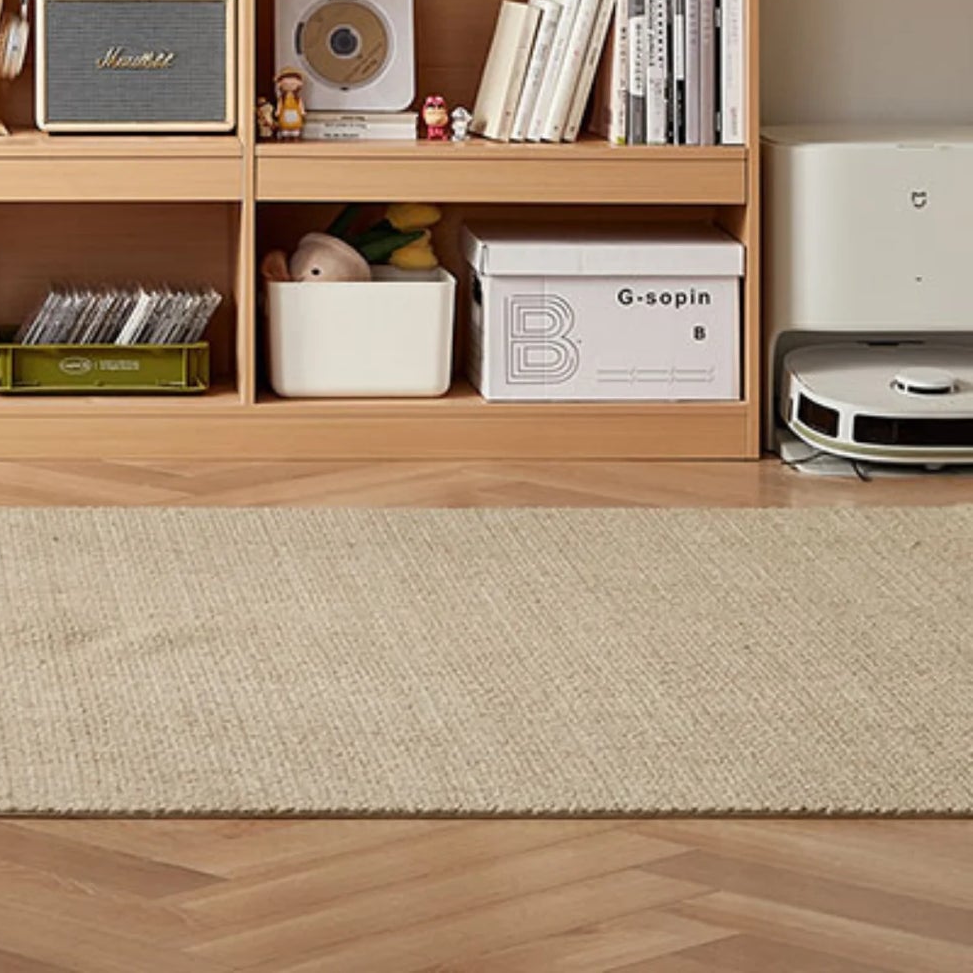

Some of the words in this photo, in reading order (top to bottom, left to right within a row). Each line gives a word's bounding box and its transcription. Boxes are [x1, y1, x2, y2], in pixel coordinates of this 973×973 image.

[617, 287, 711, 309] G-sopin
[504, 293, 580, 385] B
[692, 325, 706, 341] B
